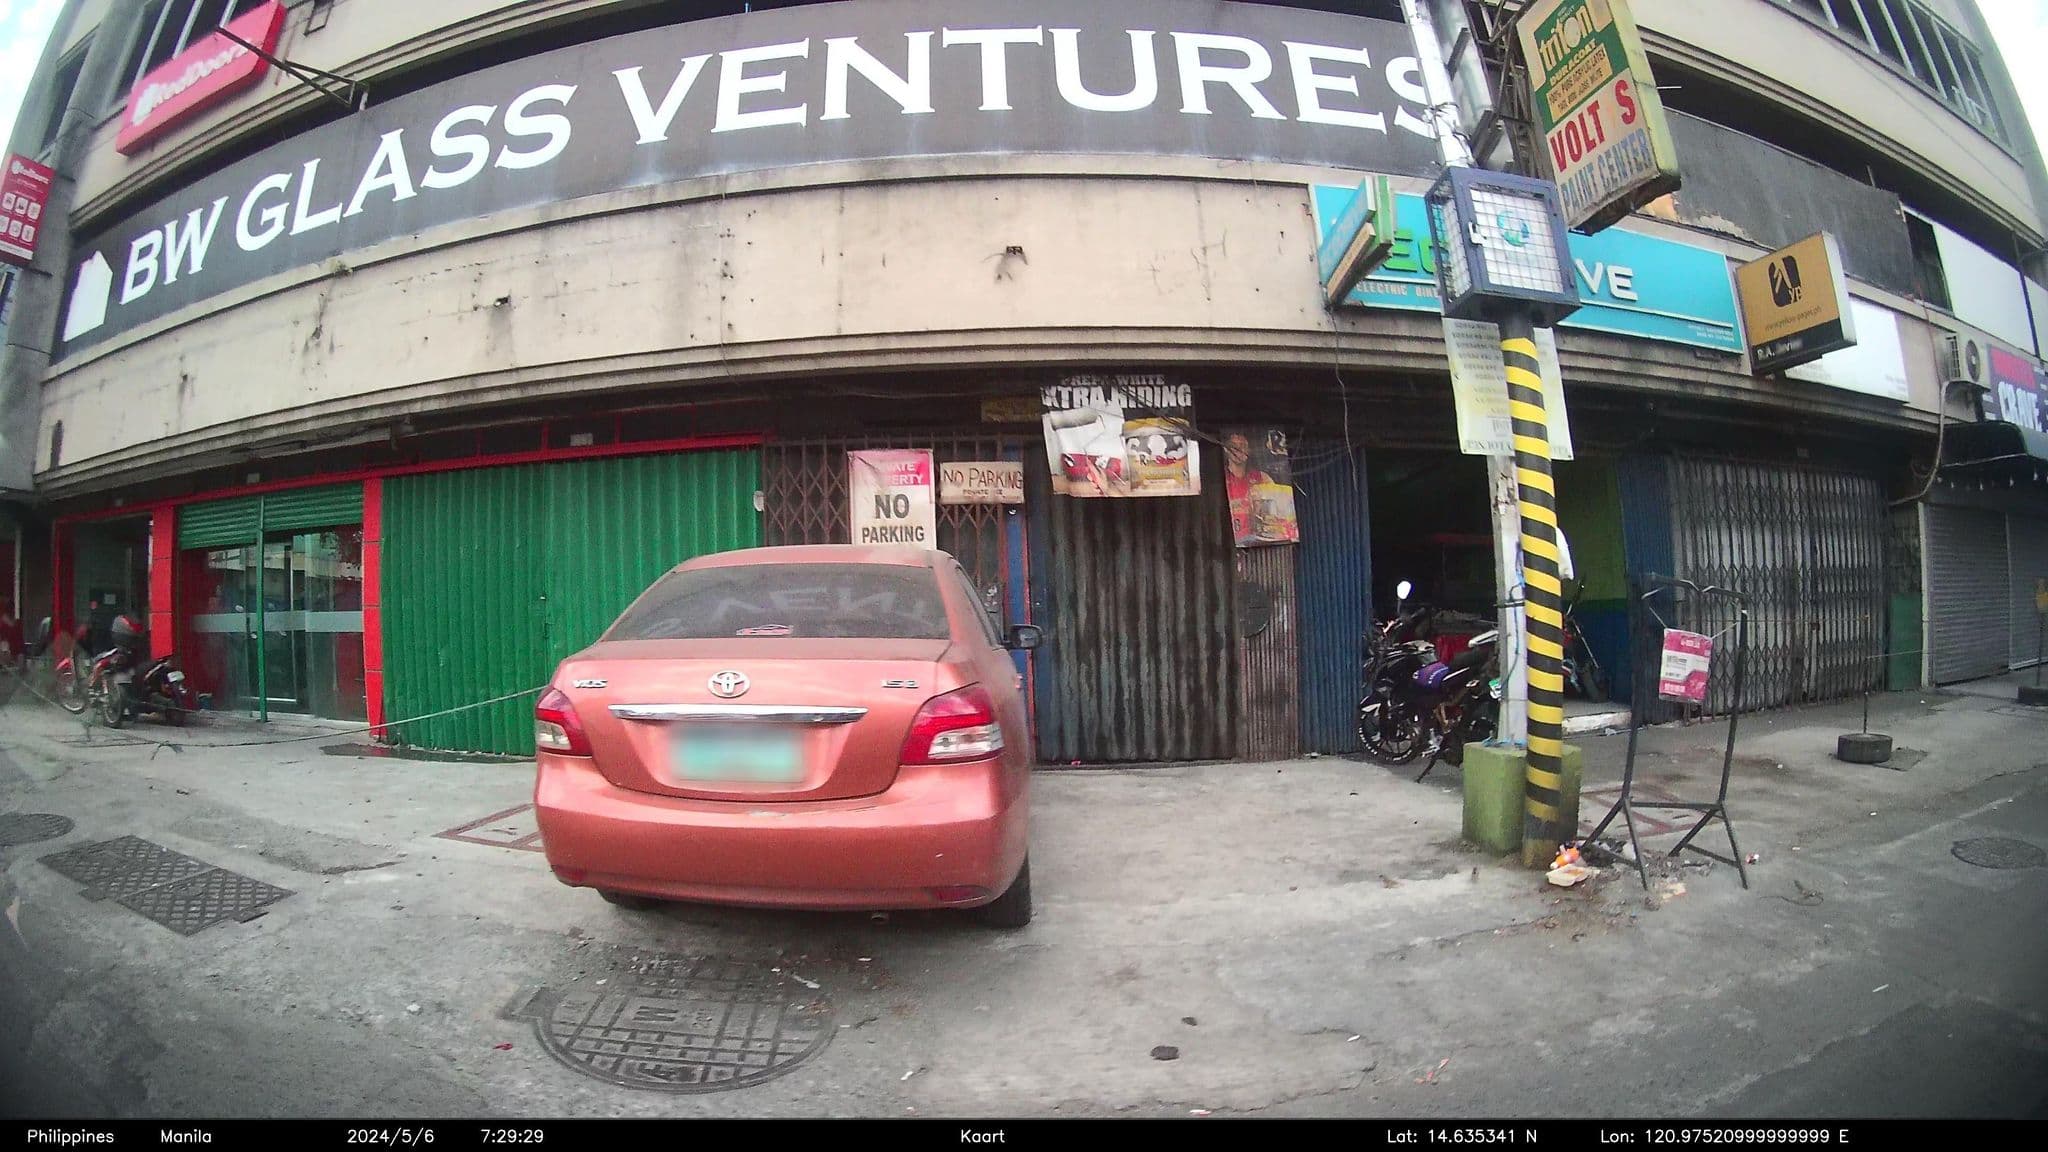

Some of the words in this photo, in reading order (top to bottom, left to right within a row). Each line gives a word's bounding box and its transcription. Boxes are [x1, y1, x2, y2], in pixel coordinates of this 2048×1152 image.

[121, 196, 228, 304] BW
[236, 84, 578, 251] GLASS
[611, 25, 1438, 145] VENTURES
[1597, 127, 1654, 194] CENTER
[943, 469, 965, 488] NO
[968, 467, 1024, 490] PARKING
[873, 493, 911, 520] NO
[861, 525, 926, 544] PARKING
